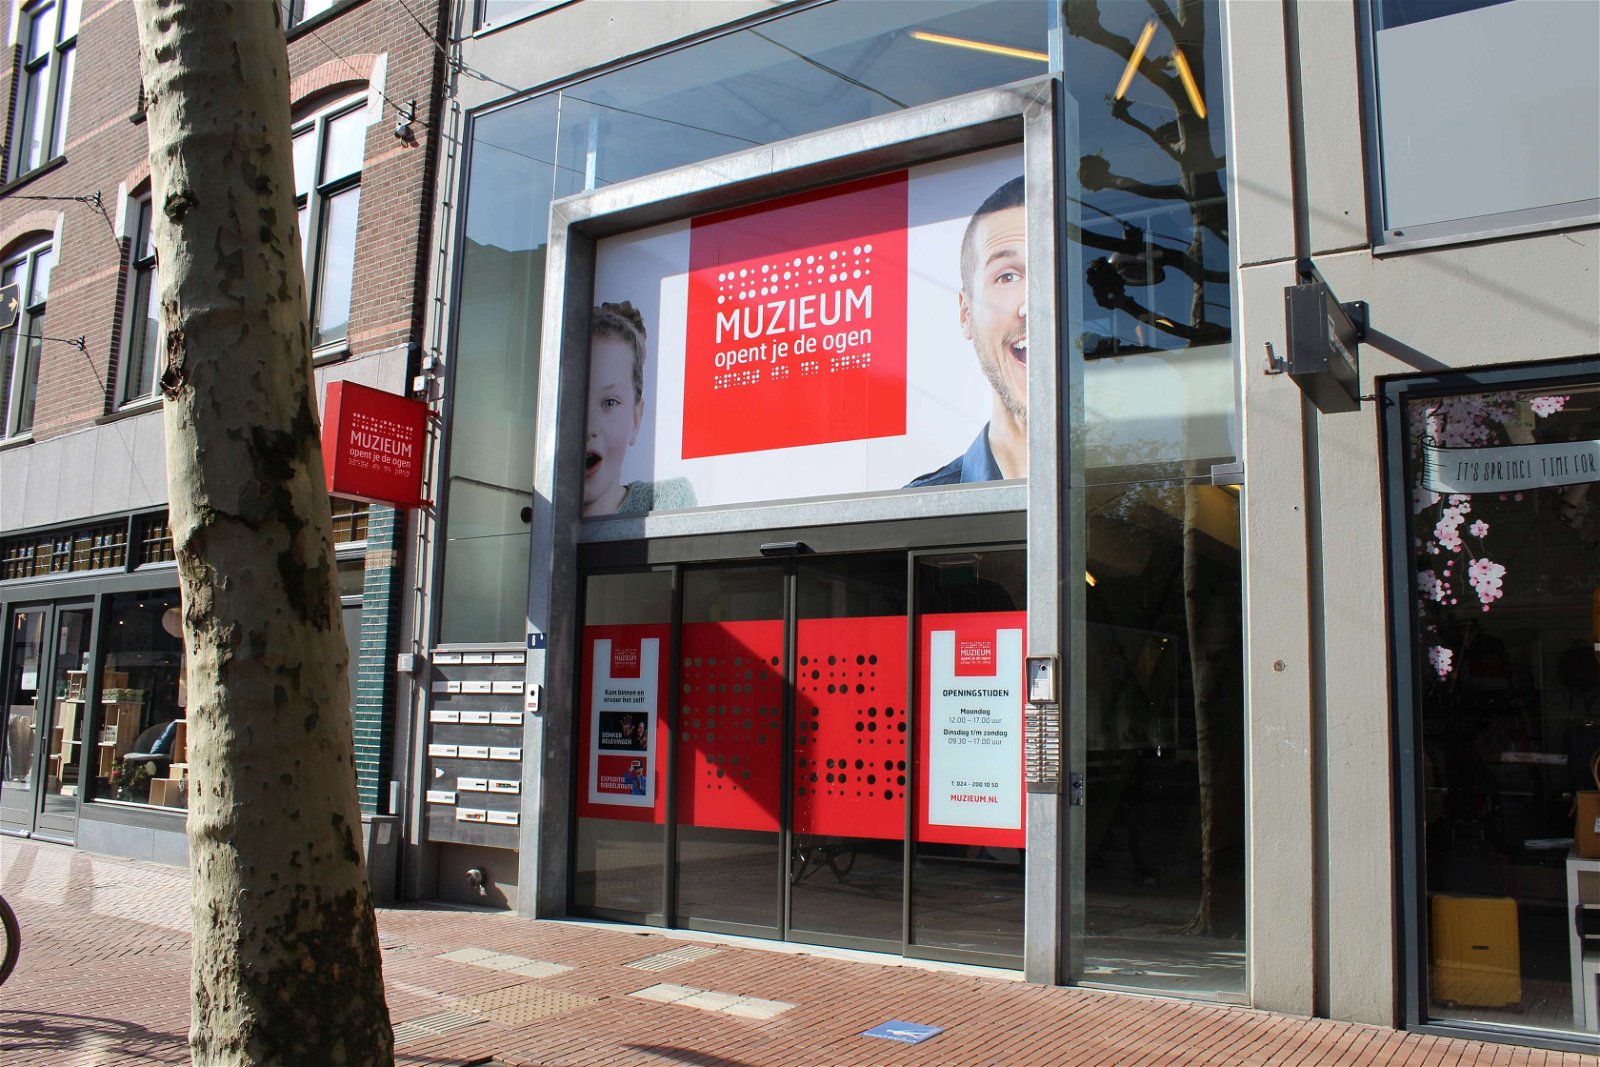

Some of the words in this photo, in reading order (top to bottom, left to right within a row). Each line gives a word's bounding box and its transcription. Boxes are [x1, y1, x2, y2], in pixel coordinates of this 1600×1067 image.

[715, 285, 872, 344] MUZIEUM
[714, 343, 767, 370] opent
[770, 339, 789, 363] je
[793, 334, 817, 355] de
[822, 328, 872, 354] ogen
[350, 430, 412, 458] MUZIEUM
[349, 448, 371, 459] opent
[372, 452, 380, 462] je
[382, 454, 391, 464] de
[392, 459, 411, 468] ogen
[1456, 462, 1479, 481] IT'S
[1541, 455, 1569, 477] TIME
[1573, 453, 1597, 474] FOR
[942, 689, 1009, 697] OPENINGSTIJDEN
[960, 708, 991, 716] Maandag
[948, 716, 966, 724] 12.00
[943, 729, 969, 737] Dinsdag
[983, 729, 1008, 737] zondag
[950, 794, 999, 804] MUZIEUM.NL
